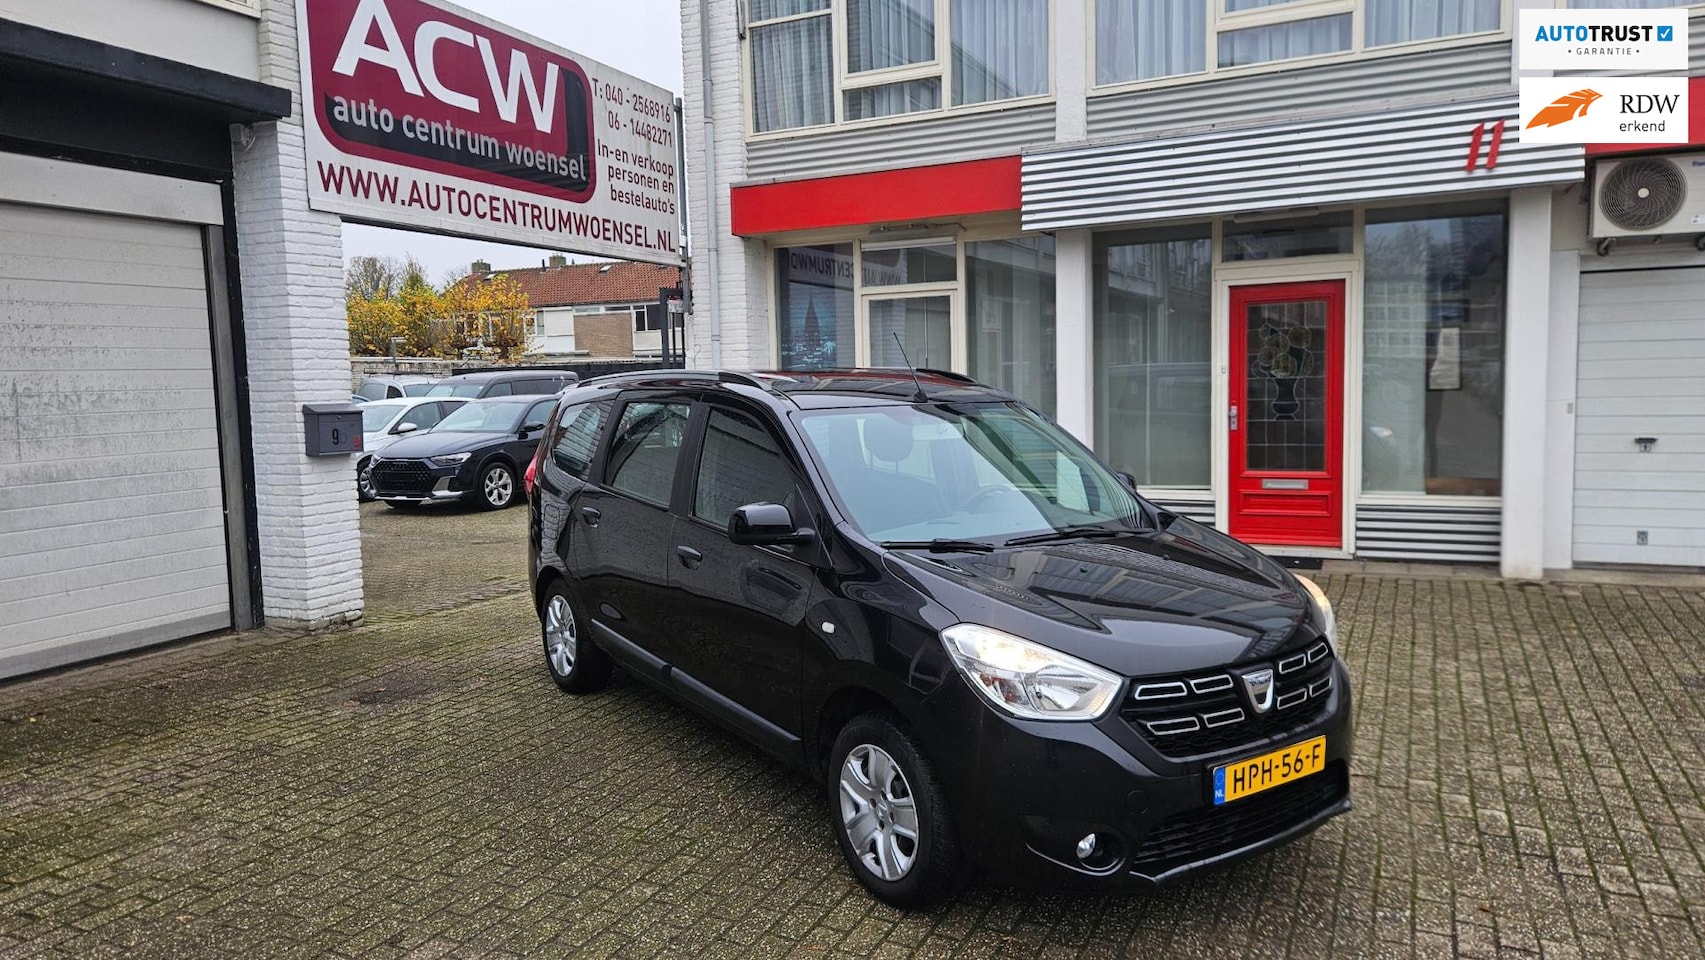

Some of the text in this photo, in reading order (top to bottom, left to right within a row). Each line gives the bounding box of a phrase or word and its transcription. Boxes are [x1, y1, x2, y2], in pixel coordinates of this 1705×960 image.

[332, 0, 560, 134] ACW
[593, 78, 603, 99] T:
[605, 83, 623, 105] 040
[632, 94, 671, 123] 2568916
[333, 95, 587, 181] auto centrum woensel
[608, 110, 620, 130] 06
[630, 118, 672, 148] 14482271
[1465, 119, 1505, 172] 11
[608, 165, 674, 194] personen en
[632, 152, 674, 180] verkoop
[317, 160, 676, 253] WWW.AUTOCENTRUMWOENSEL.NL
[610, 184, 675, 215] bestelauto's
[1233, 744, 1321, 793] HPH-56-F
[1215, 790, 1224, 798] NL
